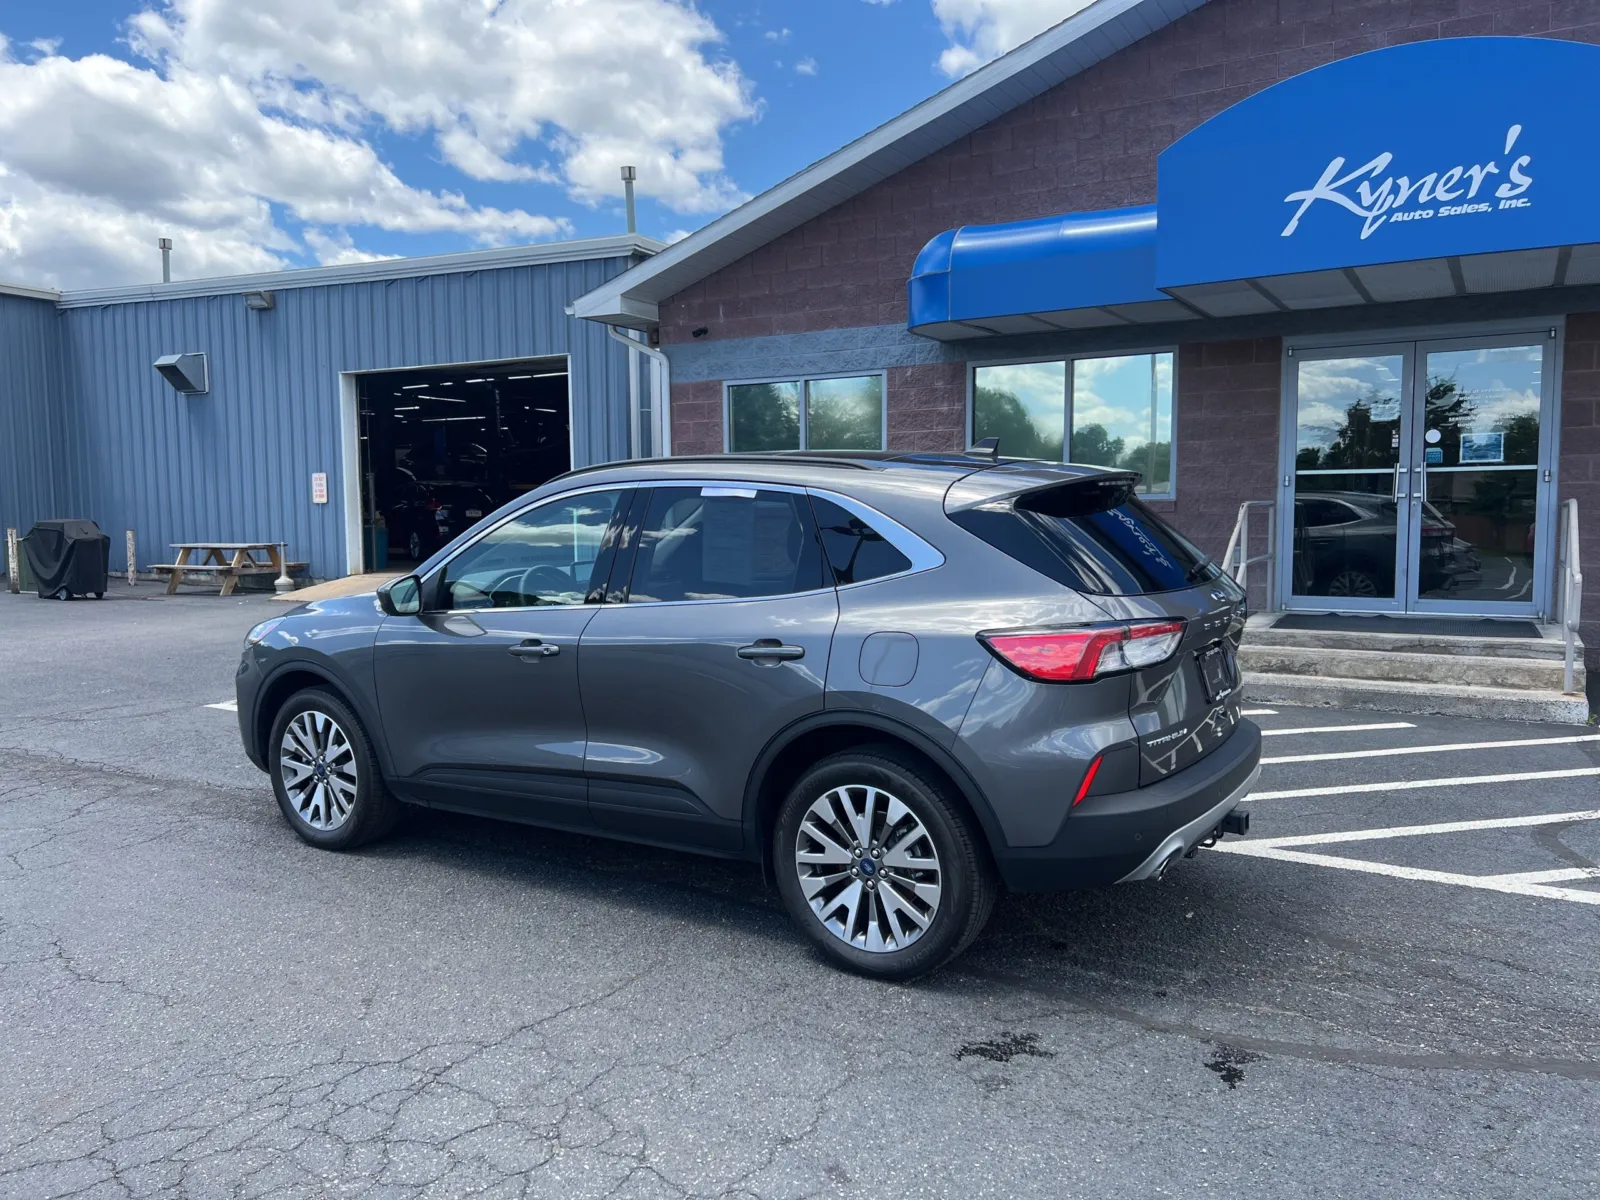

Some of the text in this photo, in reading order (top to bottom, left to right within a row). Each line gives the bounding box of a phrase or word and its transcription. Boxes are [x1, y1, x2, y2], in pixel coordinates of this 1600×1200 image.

[1281, 124, 1533, 240] Kyner's
[1389, 197, 1532, 223] Auto Sales, Inc.
